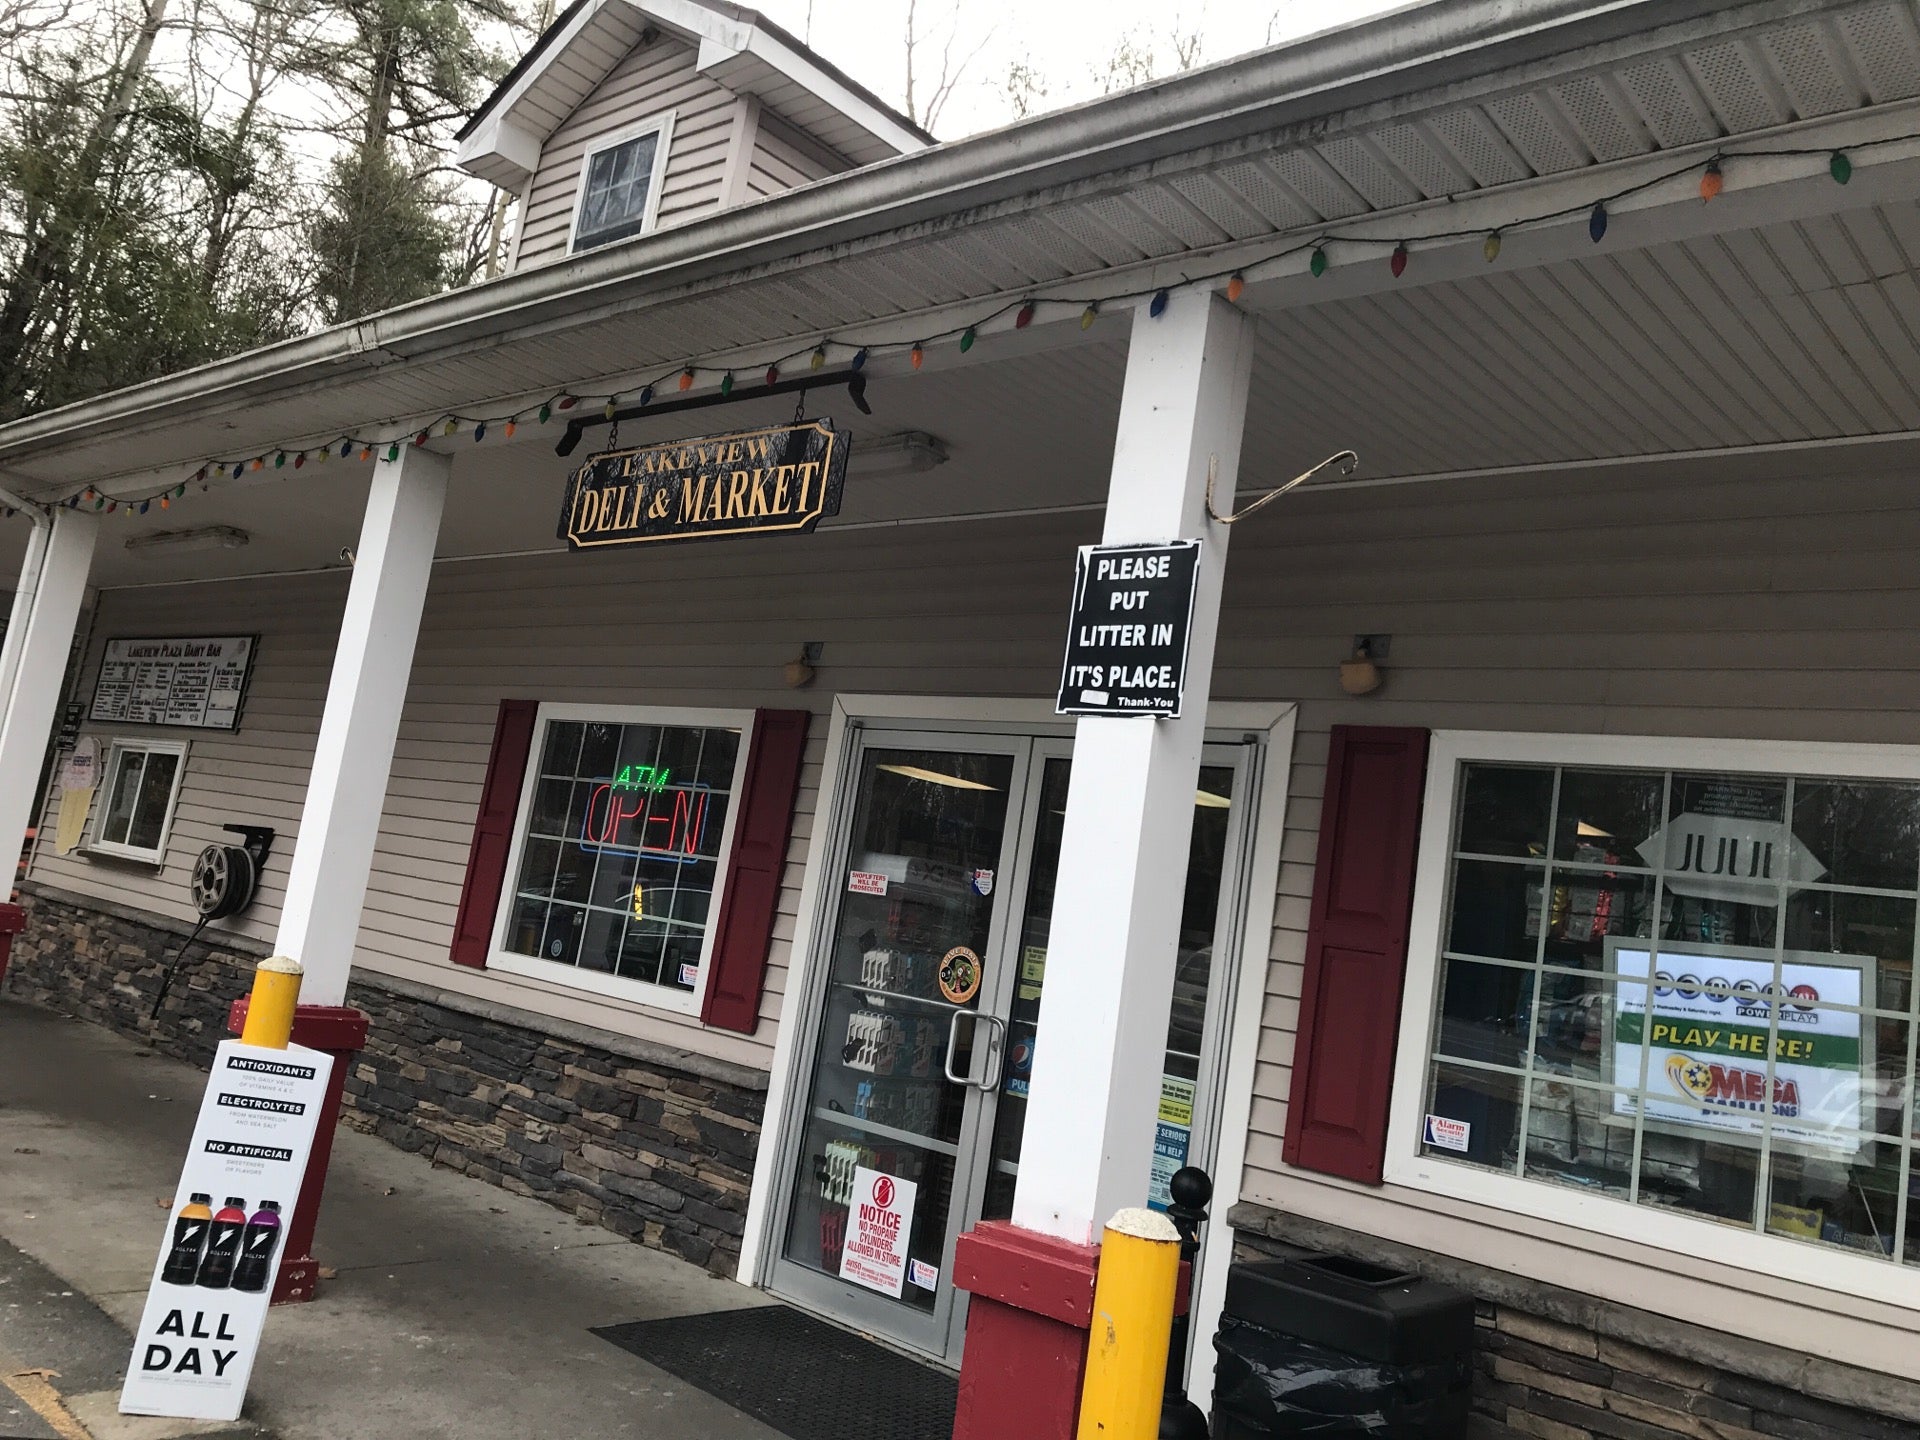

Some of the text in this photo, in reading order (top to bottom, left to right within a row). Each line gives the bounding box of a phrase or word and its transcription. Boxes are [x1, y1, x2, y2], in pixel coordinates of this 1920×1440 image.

[621, 438, 773, 477] LAKEVIEW
[577, 461, 819, 534] DELI & MARKET
[1097, 556, 1171, 581] PLEASE
[1109, 591, 1149, 611] PUT
[1079, 624, 1173, 647] LITTER IN
[128, 643, 222, 657] LAKEVIEW PLAZA DAIRY BAR
[1069, 665, 1176, 688] IT'S PLACE.
[1117, 697, 1174, 707] Thank-You
[612, 765, 669, 793] ATM
[587, 784, 706, 854] OPEN
[852, 872, 886, 881] SHOPLIFTERS
[850, 883, 884, 893] PROSECUTED
[1653, 1024, 1720, 1047] PLAY
[1728, 1033, 1814, 1059] HERE!
[230, 1060, 312, 1077] ANTIOXIDANTS
[1011, 1078, 1029, 1091] PUL
[1706, 1064, 1799, 1105] MEGA
[220, 1096, 302, 1113] ELECTROLYTES
[1161, 1128, 1187, 1142] SERIOUS
[1438, 1120, 1465, 1131] Alarm
[208, 1142, 289, 1159] NO ARTIFICIAL
[1155, 1143, 1183, 1157] CAN HELP
[859, 1203, 901, 1231] NOTICE
[858, 1219, 898, 1241] NO PROPANE
[859, 1231, 893, 1252] CYLINDERS
[847, 1239, 874, 1258] ALLOWED
[874, 1247, 882, 1260] IN
[881, 1251, 902, 1267] STORE.
[156, 1309, 235, 1341] ALL
[142, 1344, 238, 1377] DAY
